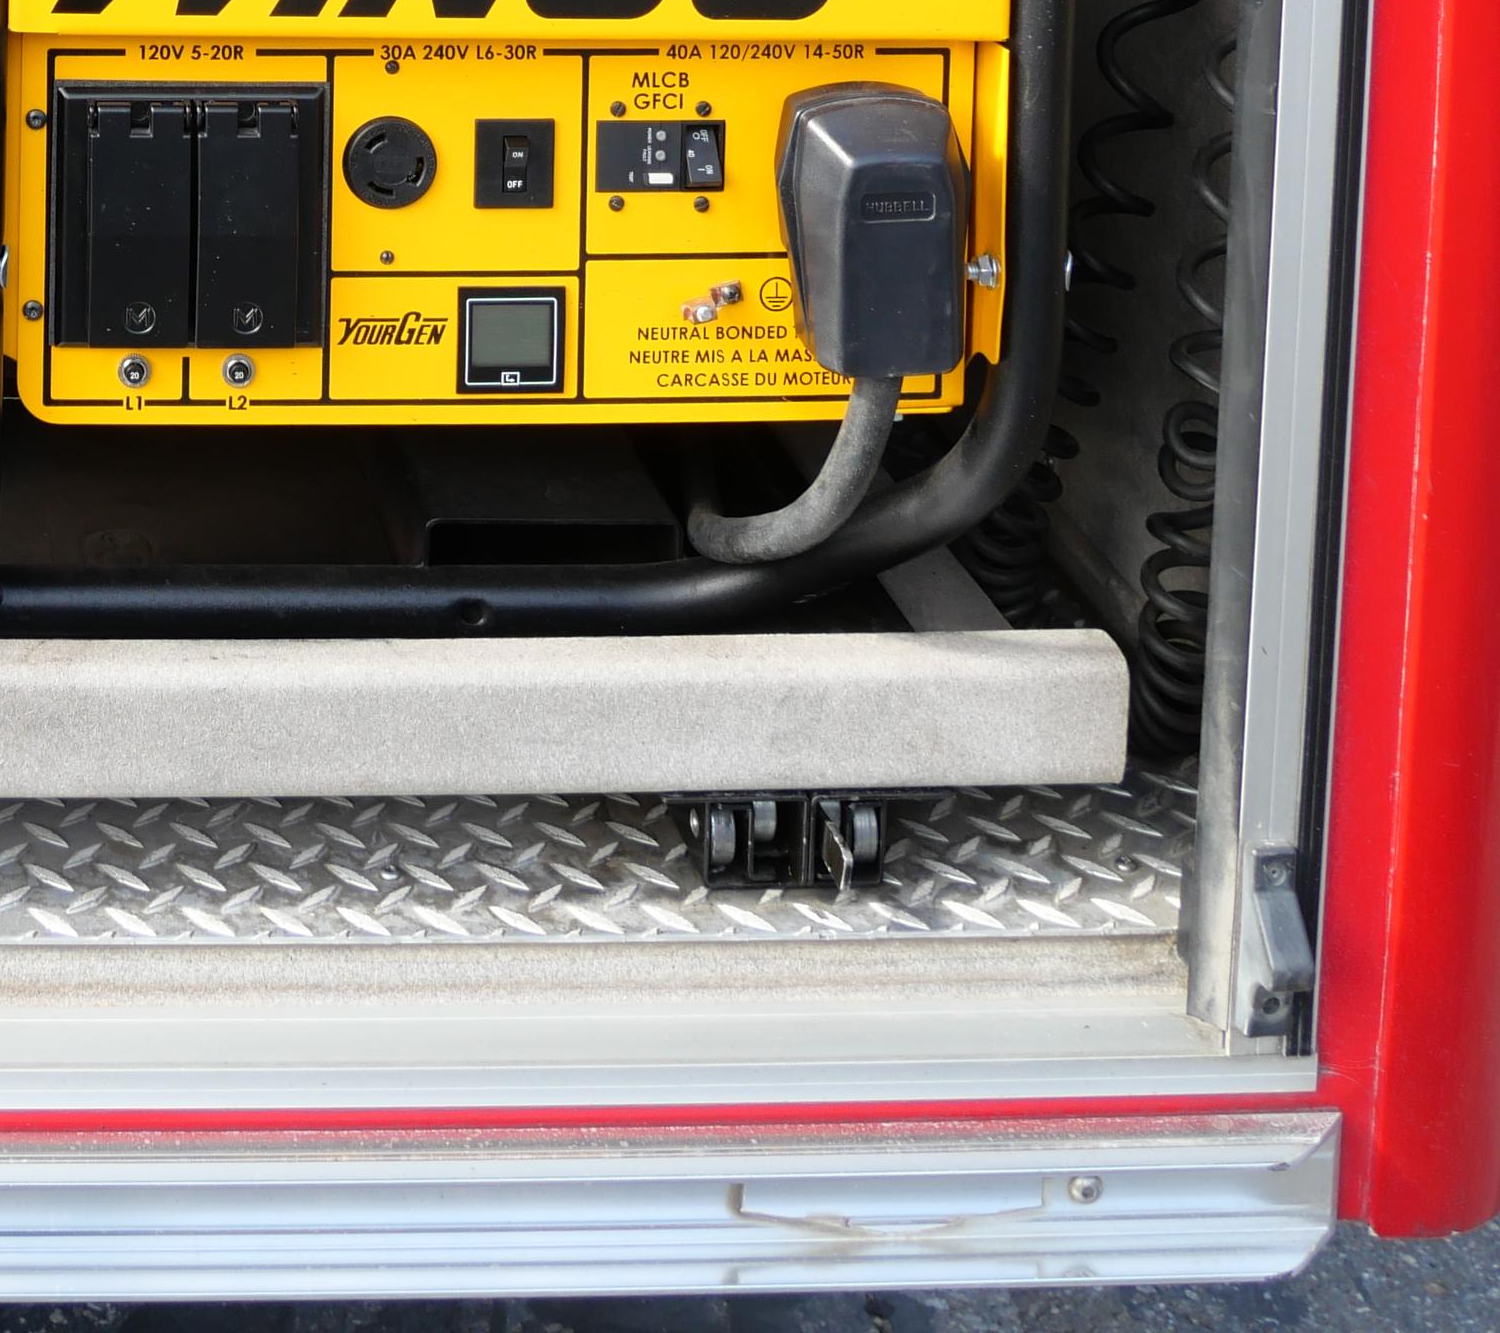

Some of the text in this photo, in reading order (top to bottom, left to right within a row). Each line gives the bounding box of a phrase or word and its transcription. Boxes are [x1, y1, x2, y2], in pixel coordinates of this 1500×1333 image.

[139, 44, 244, 60] 120V 5-20R
[380, 44, 537, 60] 30A 240V L6-30R
[666, 42, 865, 61] 40A 120/240V 14-50R
[632, 71, 690, 88] MLCB
[634, 93, 684, 110] GFCI
[511, 151, 524, 159] ON
[506, 179, 523, 189] OFF
[637, 326, 710, 341] NEUTRAL
[716, 325, 788, 340] BONDED
[629, 349, 816, 364] NEUTRE MIS A LA MAS
[129, 370, 140, 380] 20
[233, 370, 244, 380] 20
[656, 371, 852, 388] CARCASSE DU MOTEUR
[125, 396, 142, 411] L1
[227, 395, 248, 410] L2
